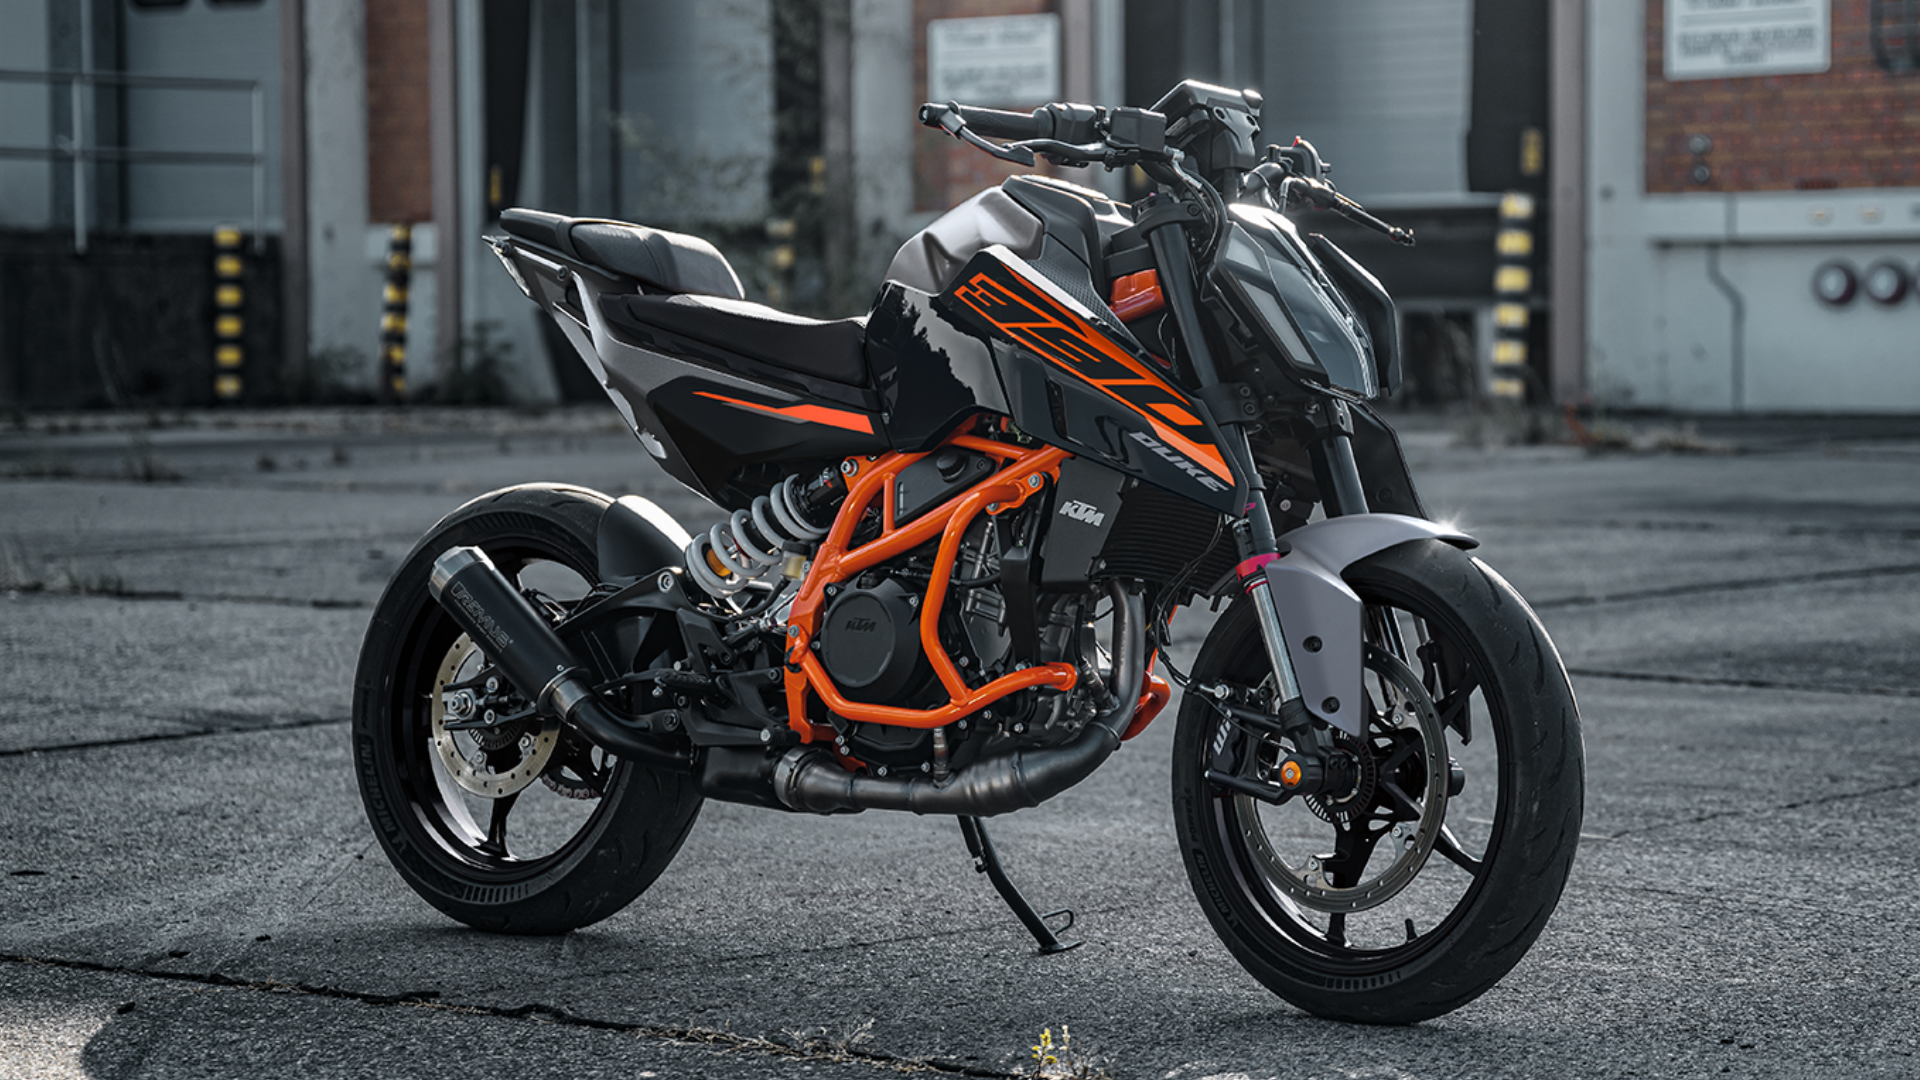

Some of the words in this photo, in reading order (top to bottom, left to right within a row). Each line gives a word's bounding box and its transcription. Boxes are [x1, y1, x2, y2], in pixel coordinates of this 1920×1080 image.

[1129, 431, 1229, 492] DUKE
[1059, 500, 1105, 527] KTM
[453, 583, 510, 648] REMUS
[845, 617, 877, 632] KTM
[360, 743, 396, 832] MICHELIN
[1197, 854, 1230, 914] MICHELIN
